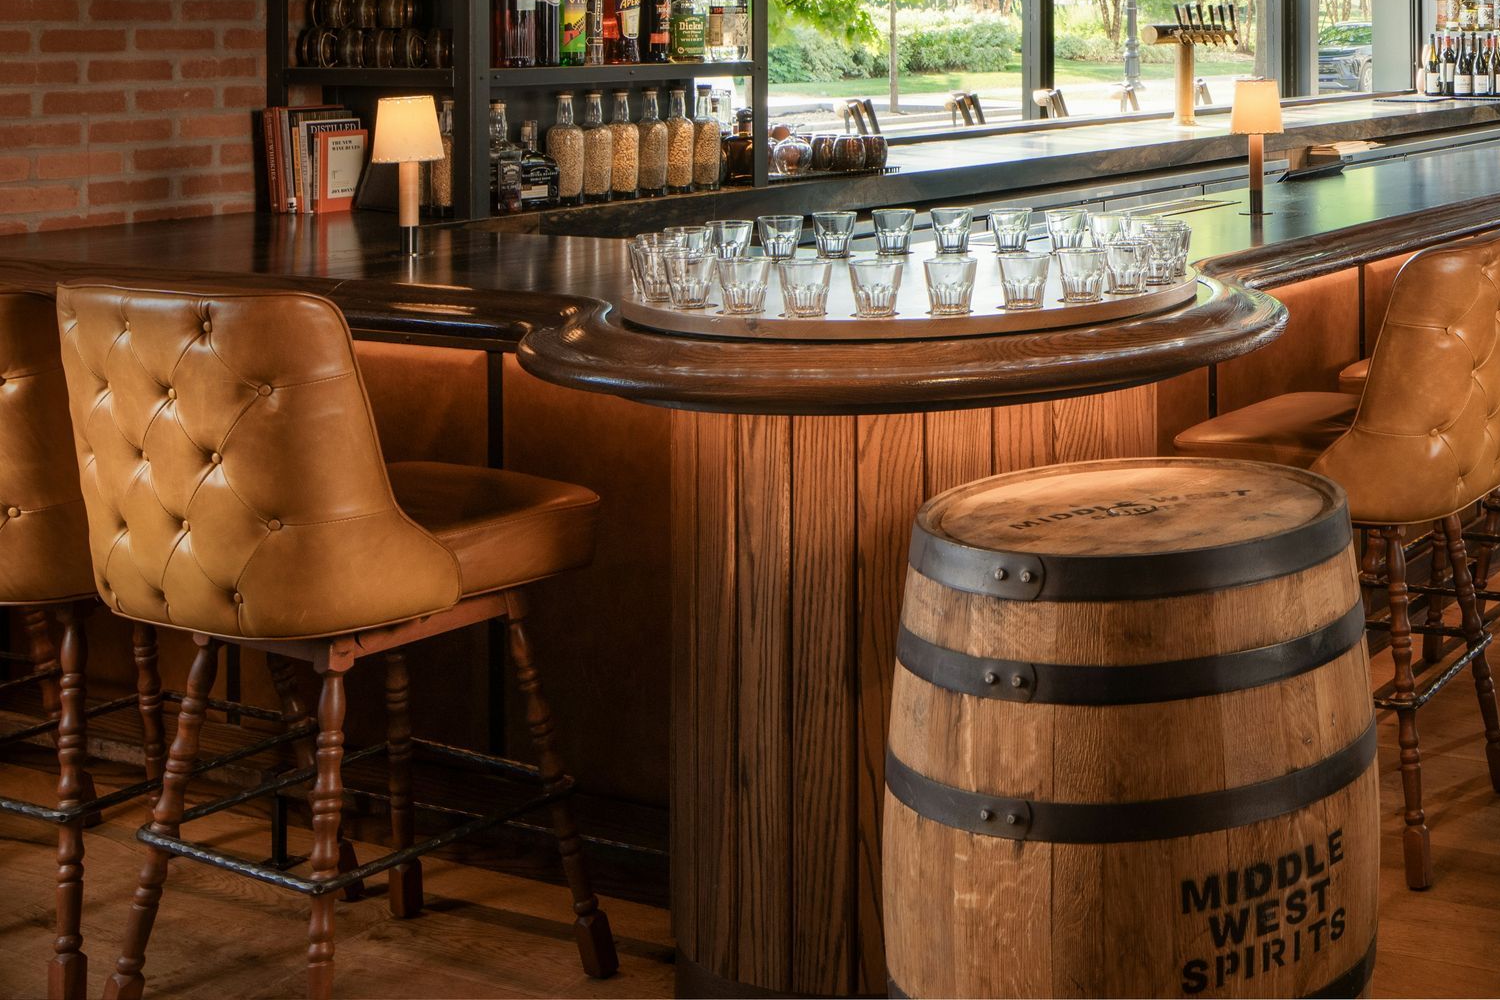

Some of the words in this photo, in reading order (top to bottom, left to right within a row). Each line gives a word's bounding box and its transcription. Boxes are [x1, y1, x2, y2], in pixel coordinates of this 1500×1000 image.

[679, 21, 704, 31] Dickel
[311, 123, 356, 134] DISTILLED
[1009, 500, 1137, 530] MIDDLE
[1149, 489, 1252, 503] WEST
[1181, 827, 1344, 915] MIDDLE
[1208, 877, 1331, 948] WEST
[1181, 906, 1346, 994] SPIRITS
